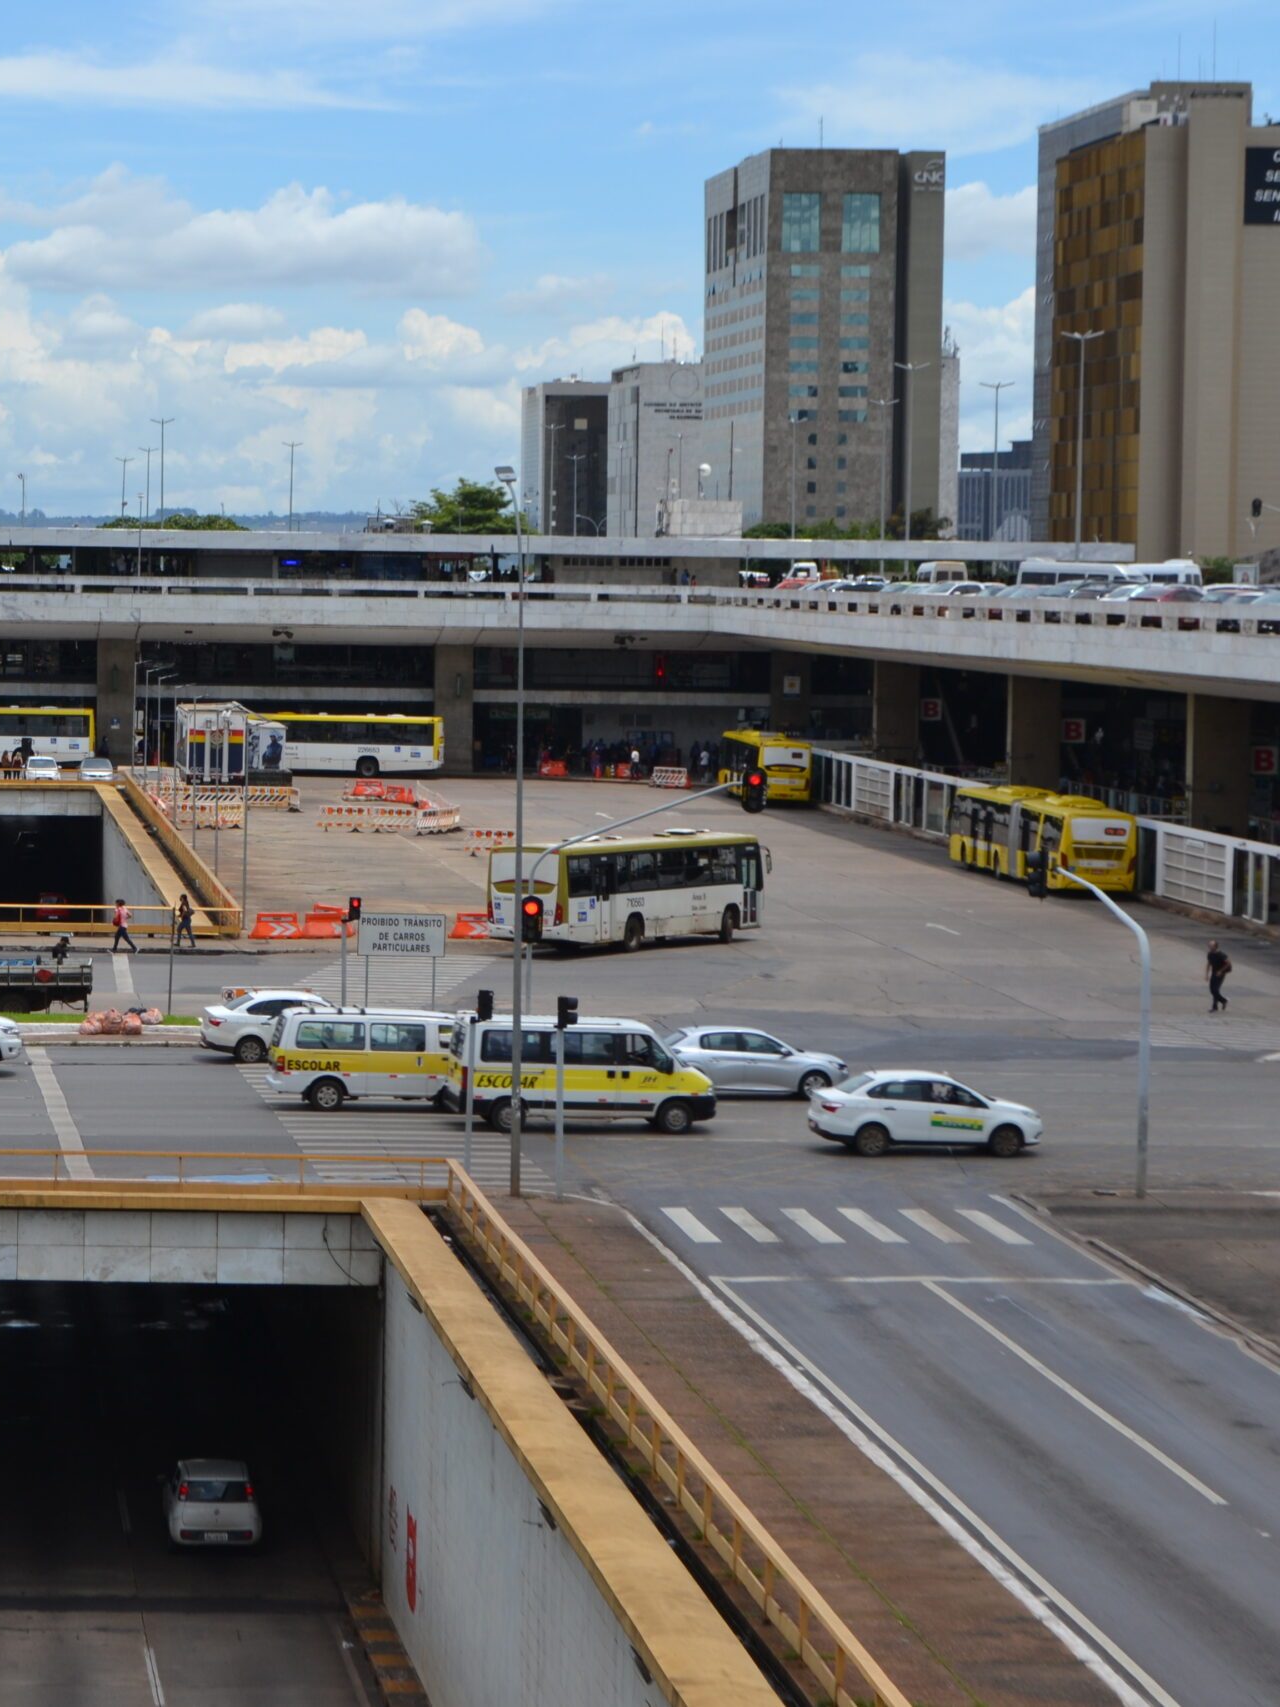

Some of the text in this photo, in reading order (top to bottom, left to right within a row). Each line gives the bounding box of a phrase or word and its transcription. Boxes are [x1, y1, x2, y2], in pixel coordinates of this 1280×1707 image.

[923, 699, 940, 718] B
[1064, 720, 1083, 742] B
[1254, 748, 1275, 772] B
[361, 916, 442, 928] PROIBIDO TRÂNSITO
[378, 932, 426, 942] DE CARROS
[372, 943, 431, 953] PARTICULARES
[286, 1059, 341, 1072] ESCOLAR
[476, 1074, 539, 1089] ESCOAR
